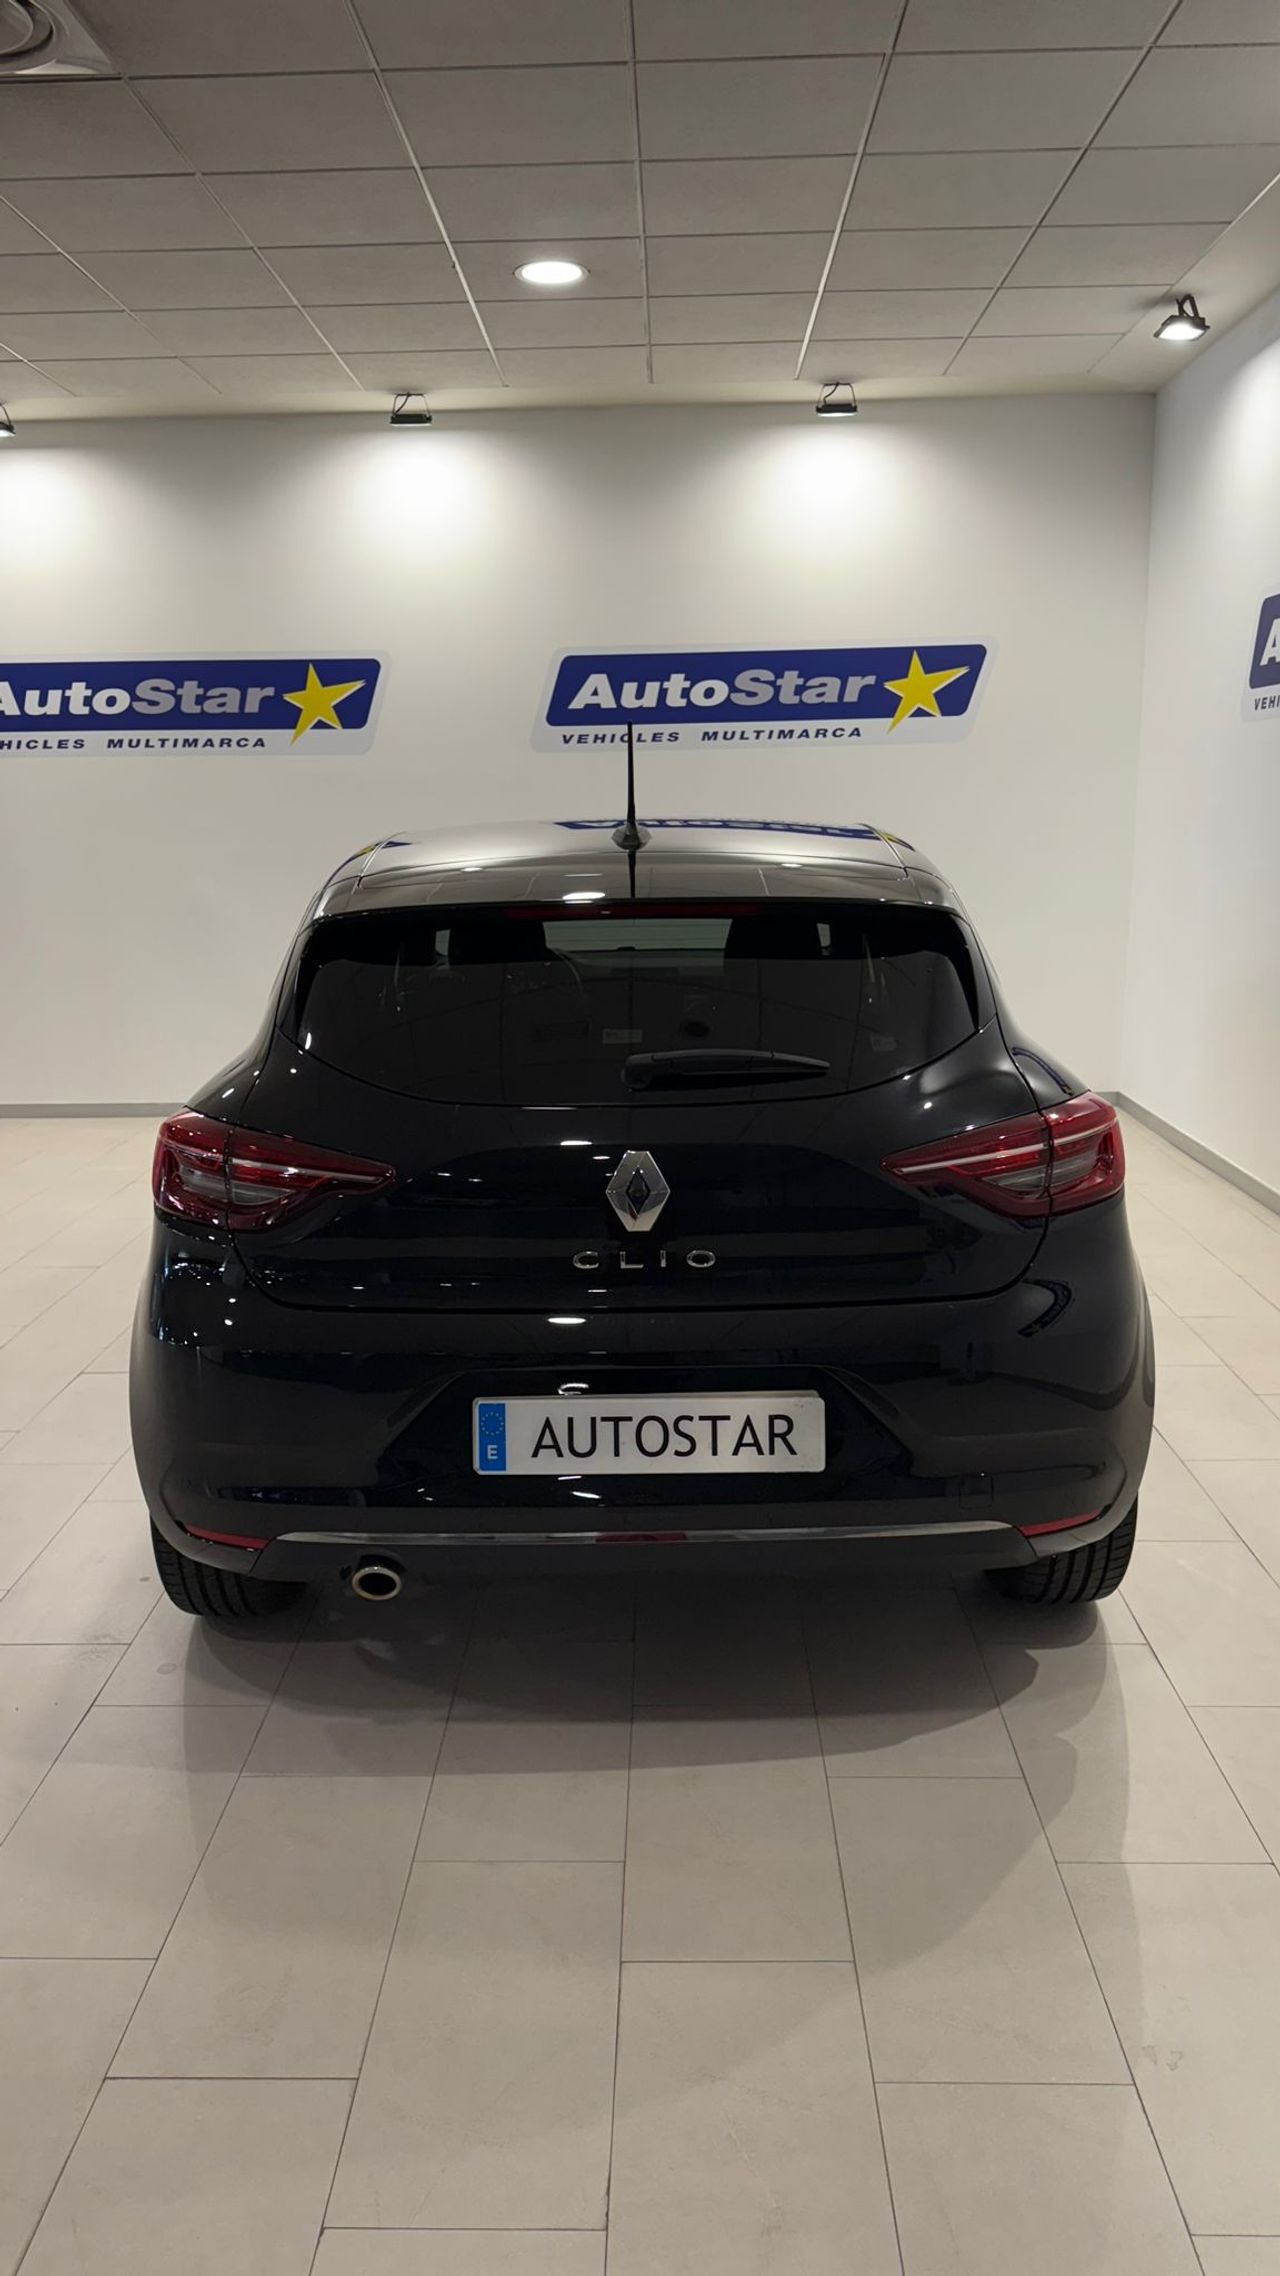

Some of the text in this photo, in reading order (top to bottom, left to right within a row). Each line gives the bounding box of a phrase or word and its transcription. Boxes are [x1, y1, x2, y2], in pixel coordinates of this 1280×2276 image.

[567, 669, 876, 710] AutoStar
[106, 737, 266, 749] MULTIMARCA
[561, 727, 863, 745] VEHICLES MULTIMARCA
[572, 1249, 716, 1270] CLIO
[530, 1414, 798, 1459] AUTOSTAR
[486, 1444, 499, 1460] E
